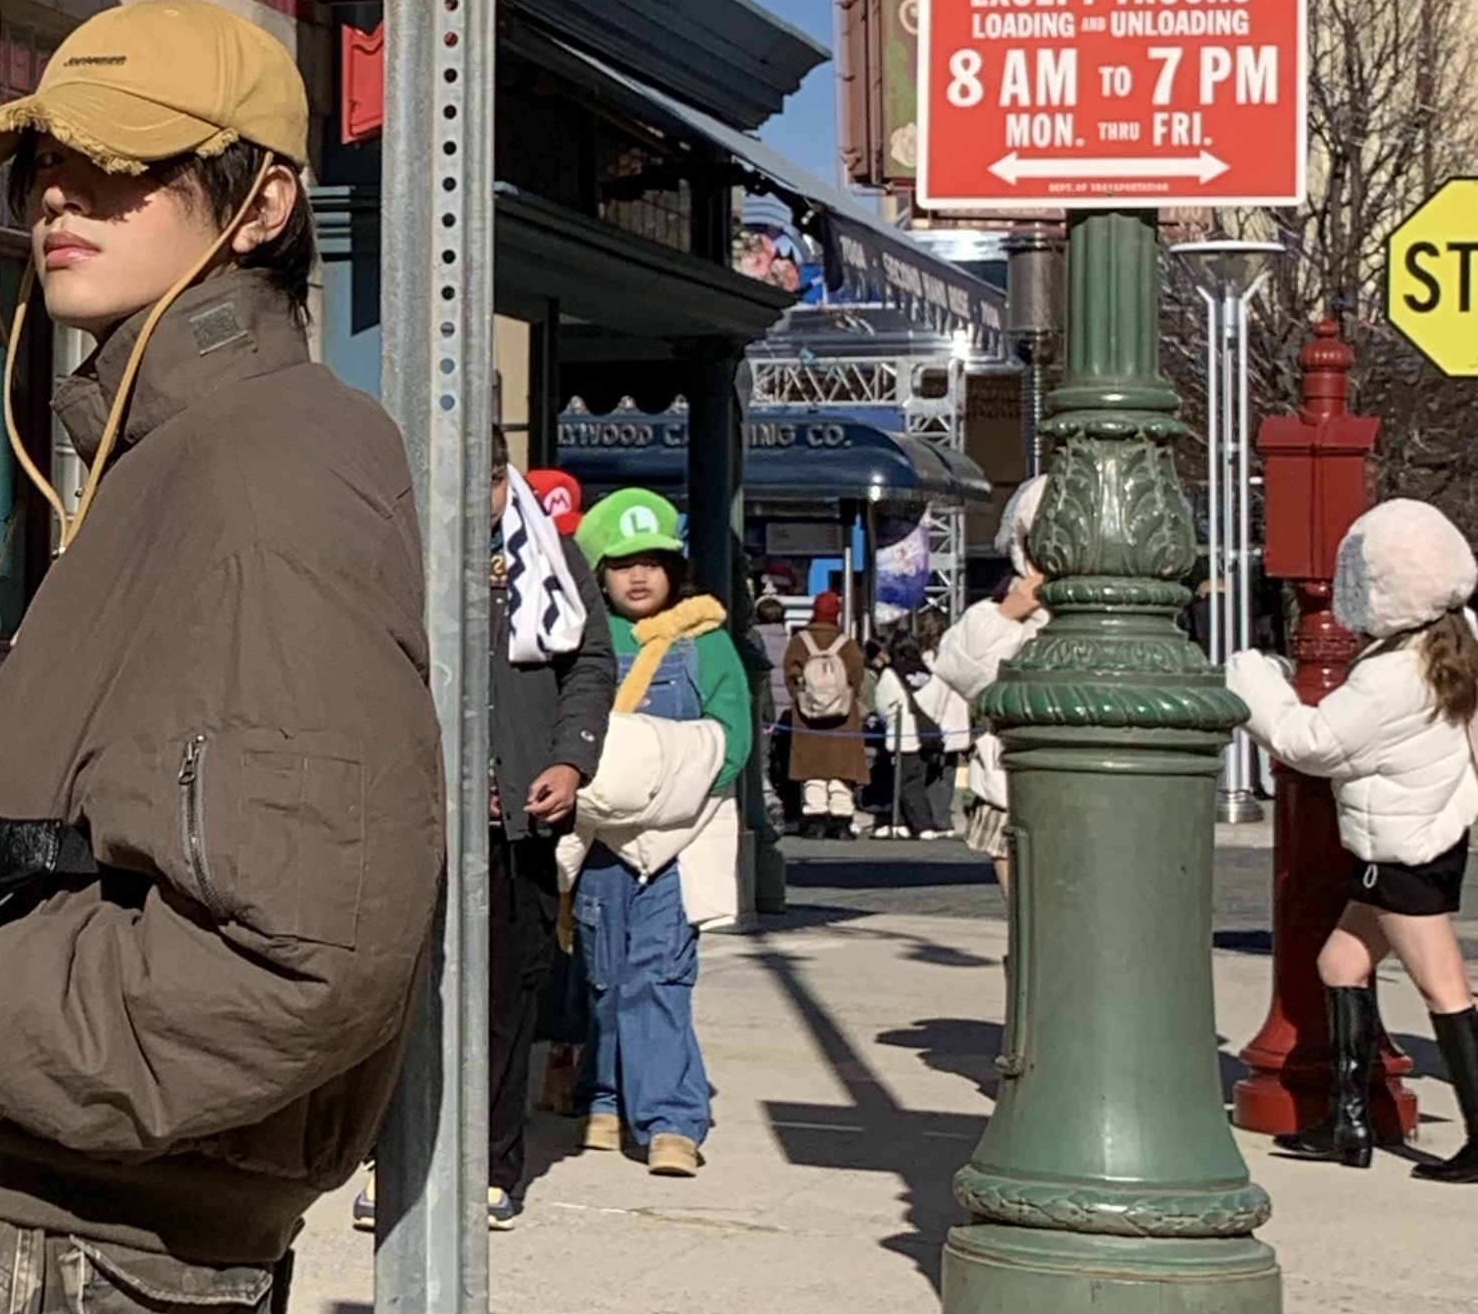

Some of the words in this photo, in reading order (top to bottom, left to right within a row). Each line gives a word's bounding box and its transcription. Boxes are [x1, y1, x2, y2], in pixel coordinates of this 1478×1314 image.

[972, 11, 1075, 40] LOADING
[1081, 16, 1106, 32] AND
[1110, 10, 1250, 38] UNLOADING
[946, 49, 983, 107] 8
[999, 48, 1077, 107] AM
[1099, 66, 1132, 98] TO
[1148, 46, 1183, 106] 7
[1200, 45, 1278, 105] PM
[1006, 113, 1084, 148] MON.
[1098, 123, 1140, 141] THRU
[1153, 112, 1213, 146] FRI.
[806, 424, 852, 447] CO.
[548, 494, 570, 516] M
[630, 512, 650, 533] L
